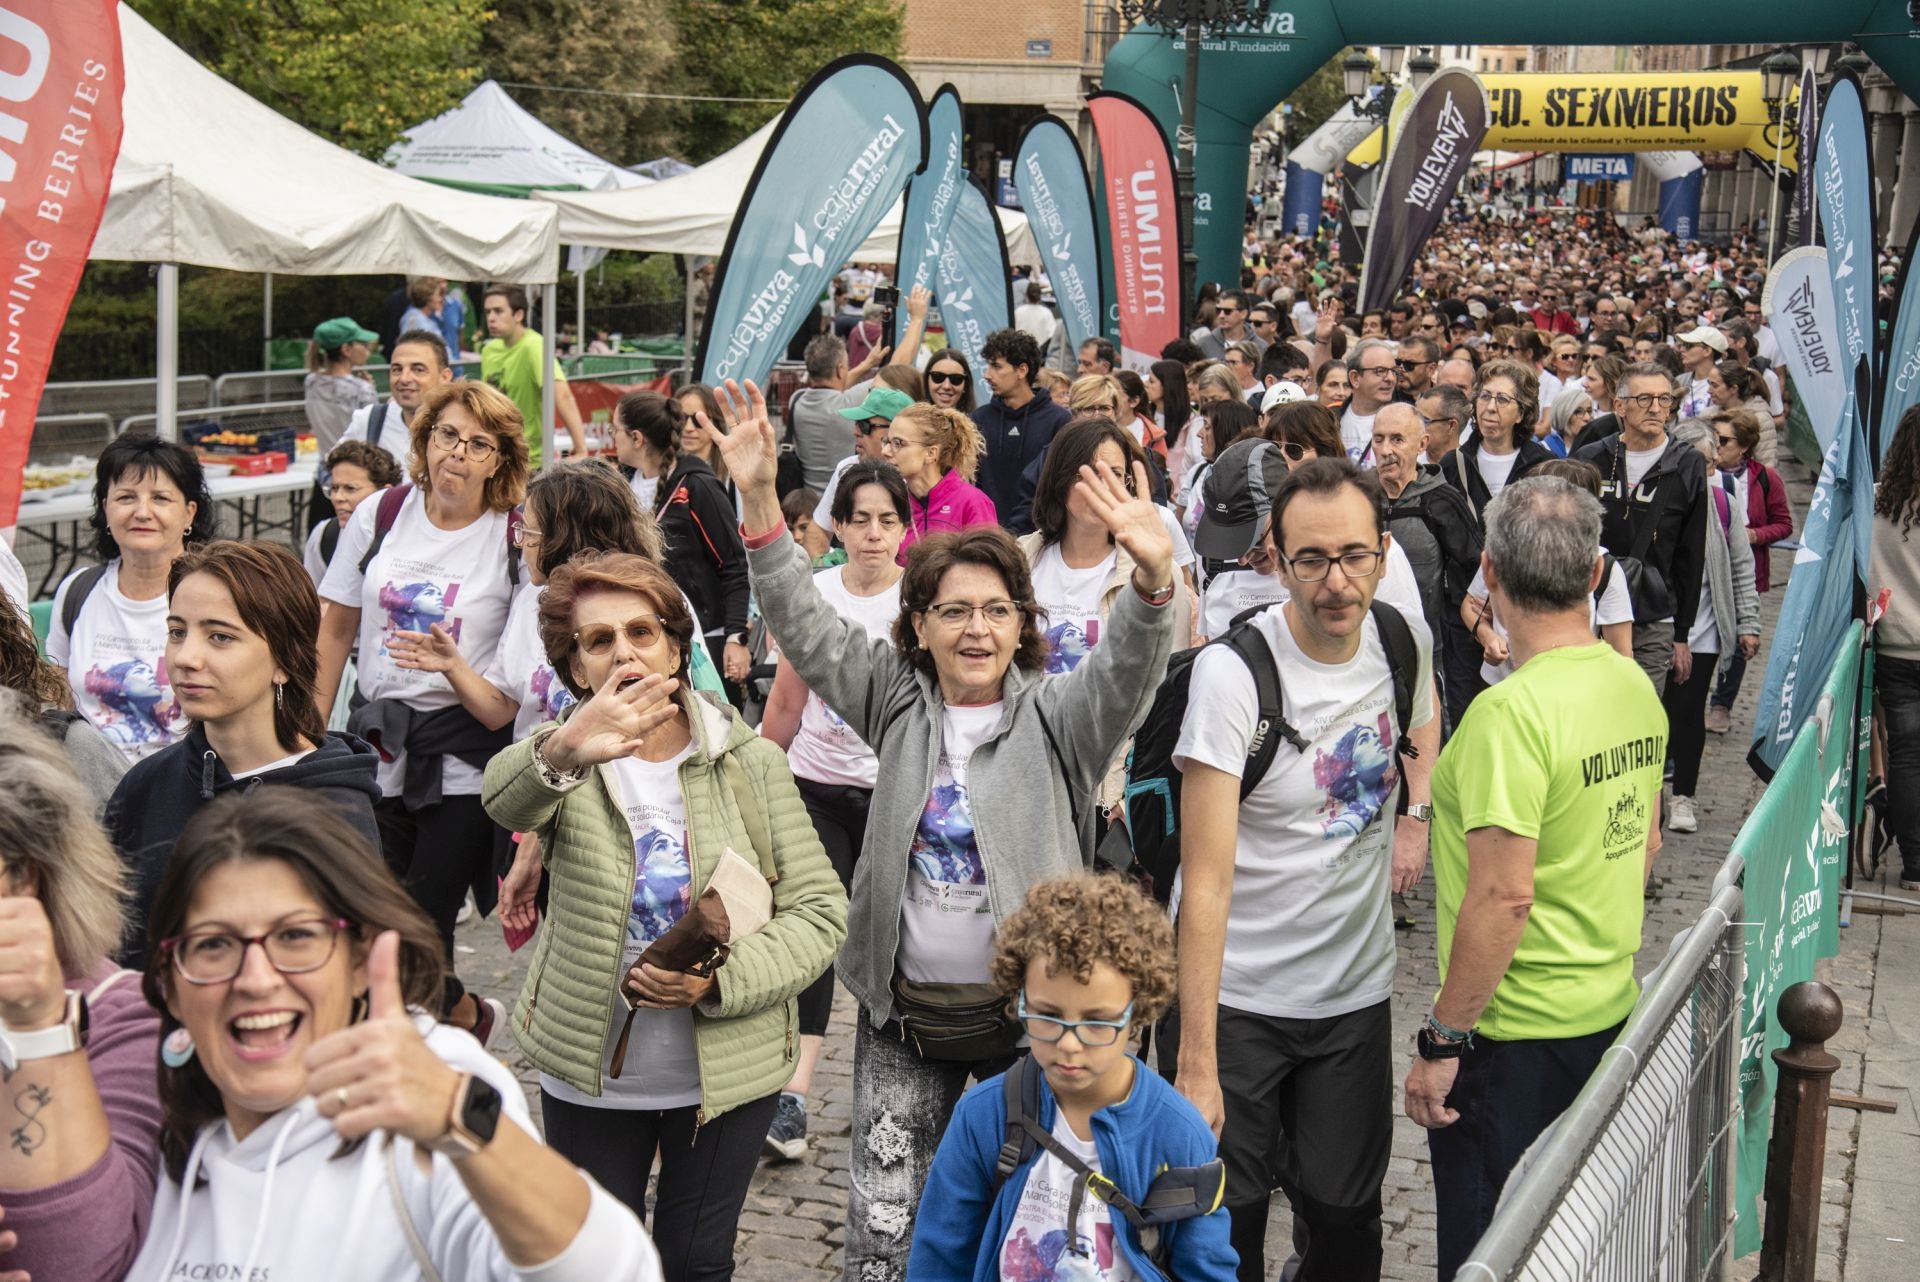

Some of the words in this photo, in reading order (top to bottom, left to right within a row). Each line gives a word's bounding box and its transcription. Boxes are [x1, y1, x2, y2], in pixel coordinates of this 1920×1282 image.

[1229, 41, 1290, 53] Fundación
[1541, 85, 1739, 133] SEXMEROS
[1501, 136, 1554, 145] Comunidad
[1556, 136, 1568, 145] de
[1570, 136, 1579, 145] la
[1581, 136, 1614, 145] Ciudad
[1615, 138, 1622, 147] y
[1624, 136, 1653, 145] Tierra
[1655, 136, 1667, 145] de
[1668, 136, 1707, 147] Segovia
[813, 113, 905, 232] cajarural
[1571, 156, 1629, 176] META
[0, 239, 52, 429] TUNNING
[37, 59, 107, 224] BERRIES
[715, 268, 795, 381] cajaviva
[754, 282, 801, 343] Segovia
[1247, 719, 1270, 757] NITRO
[642, 804, 671, 815] popular
[665, 815, 682, 825] Caja
